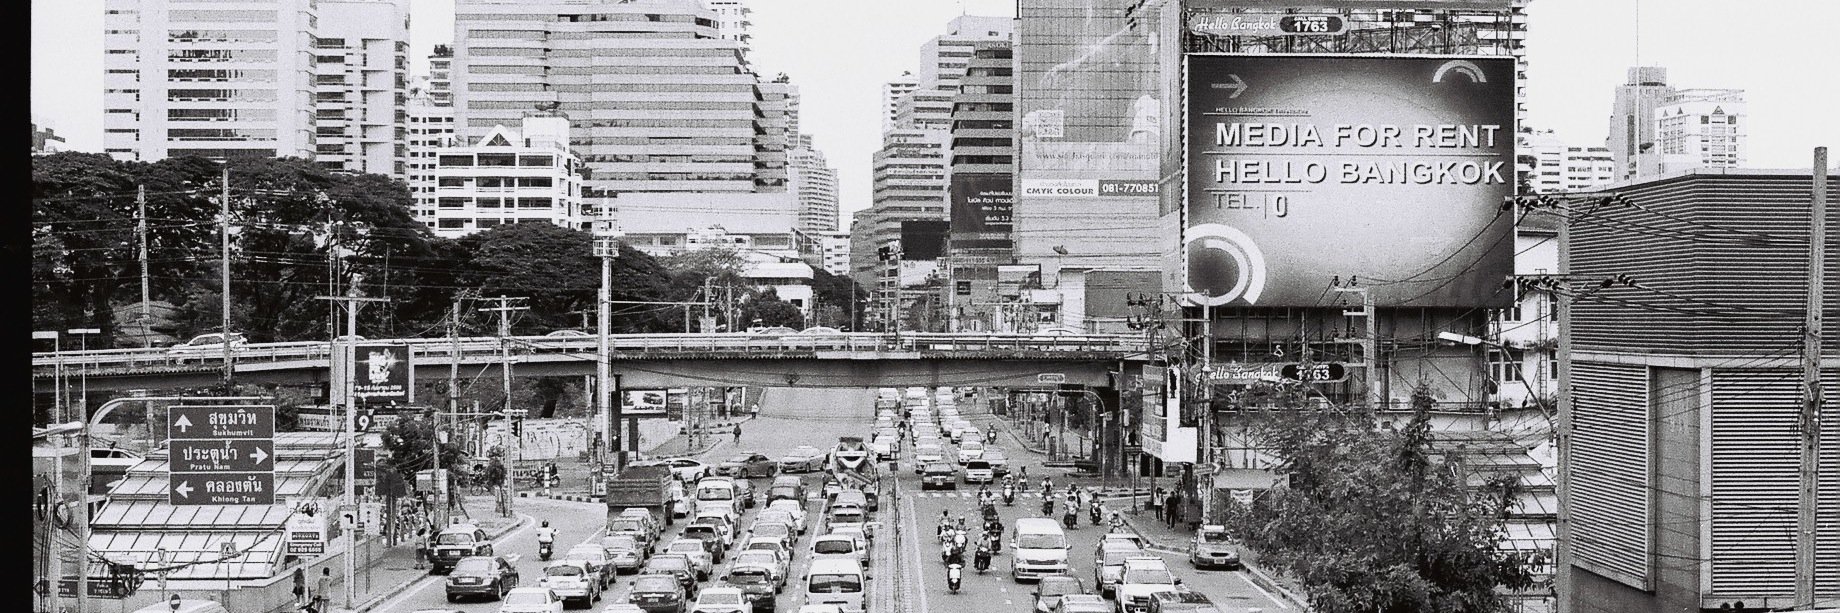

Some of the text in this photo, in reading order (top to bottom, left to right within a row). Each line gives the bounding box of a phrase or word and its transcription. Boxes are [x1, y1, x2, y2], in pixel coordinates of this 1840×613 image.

[1195, 16, 1277, 33] Hello Bangkok
[1294, 22, 1328, 32] 1763
[1216, 122, 1501, 148] MEDIA FOR RENT
[1215, 159, 1506, 185] HELLO BANGKOK
[1102, 183, 1159, 193] 081-770851
[1211, 191, 1260, 209] TEL.
[1196, 366, 1229, 382] ello
[209, 408, 257, 430] สุขุมวิท
[182, 440, 238, 465] ประตูน้ำ
[205, 475, 263, 493] คลองตัน
[212, 495, 239, 503] Khlong
